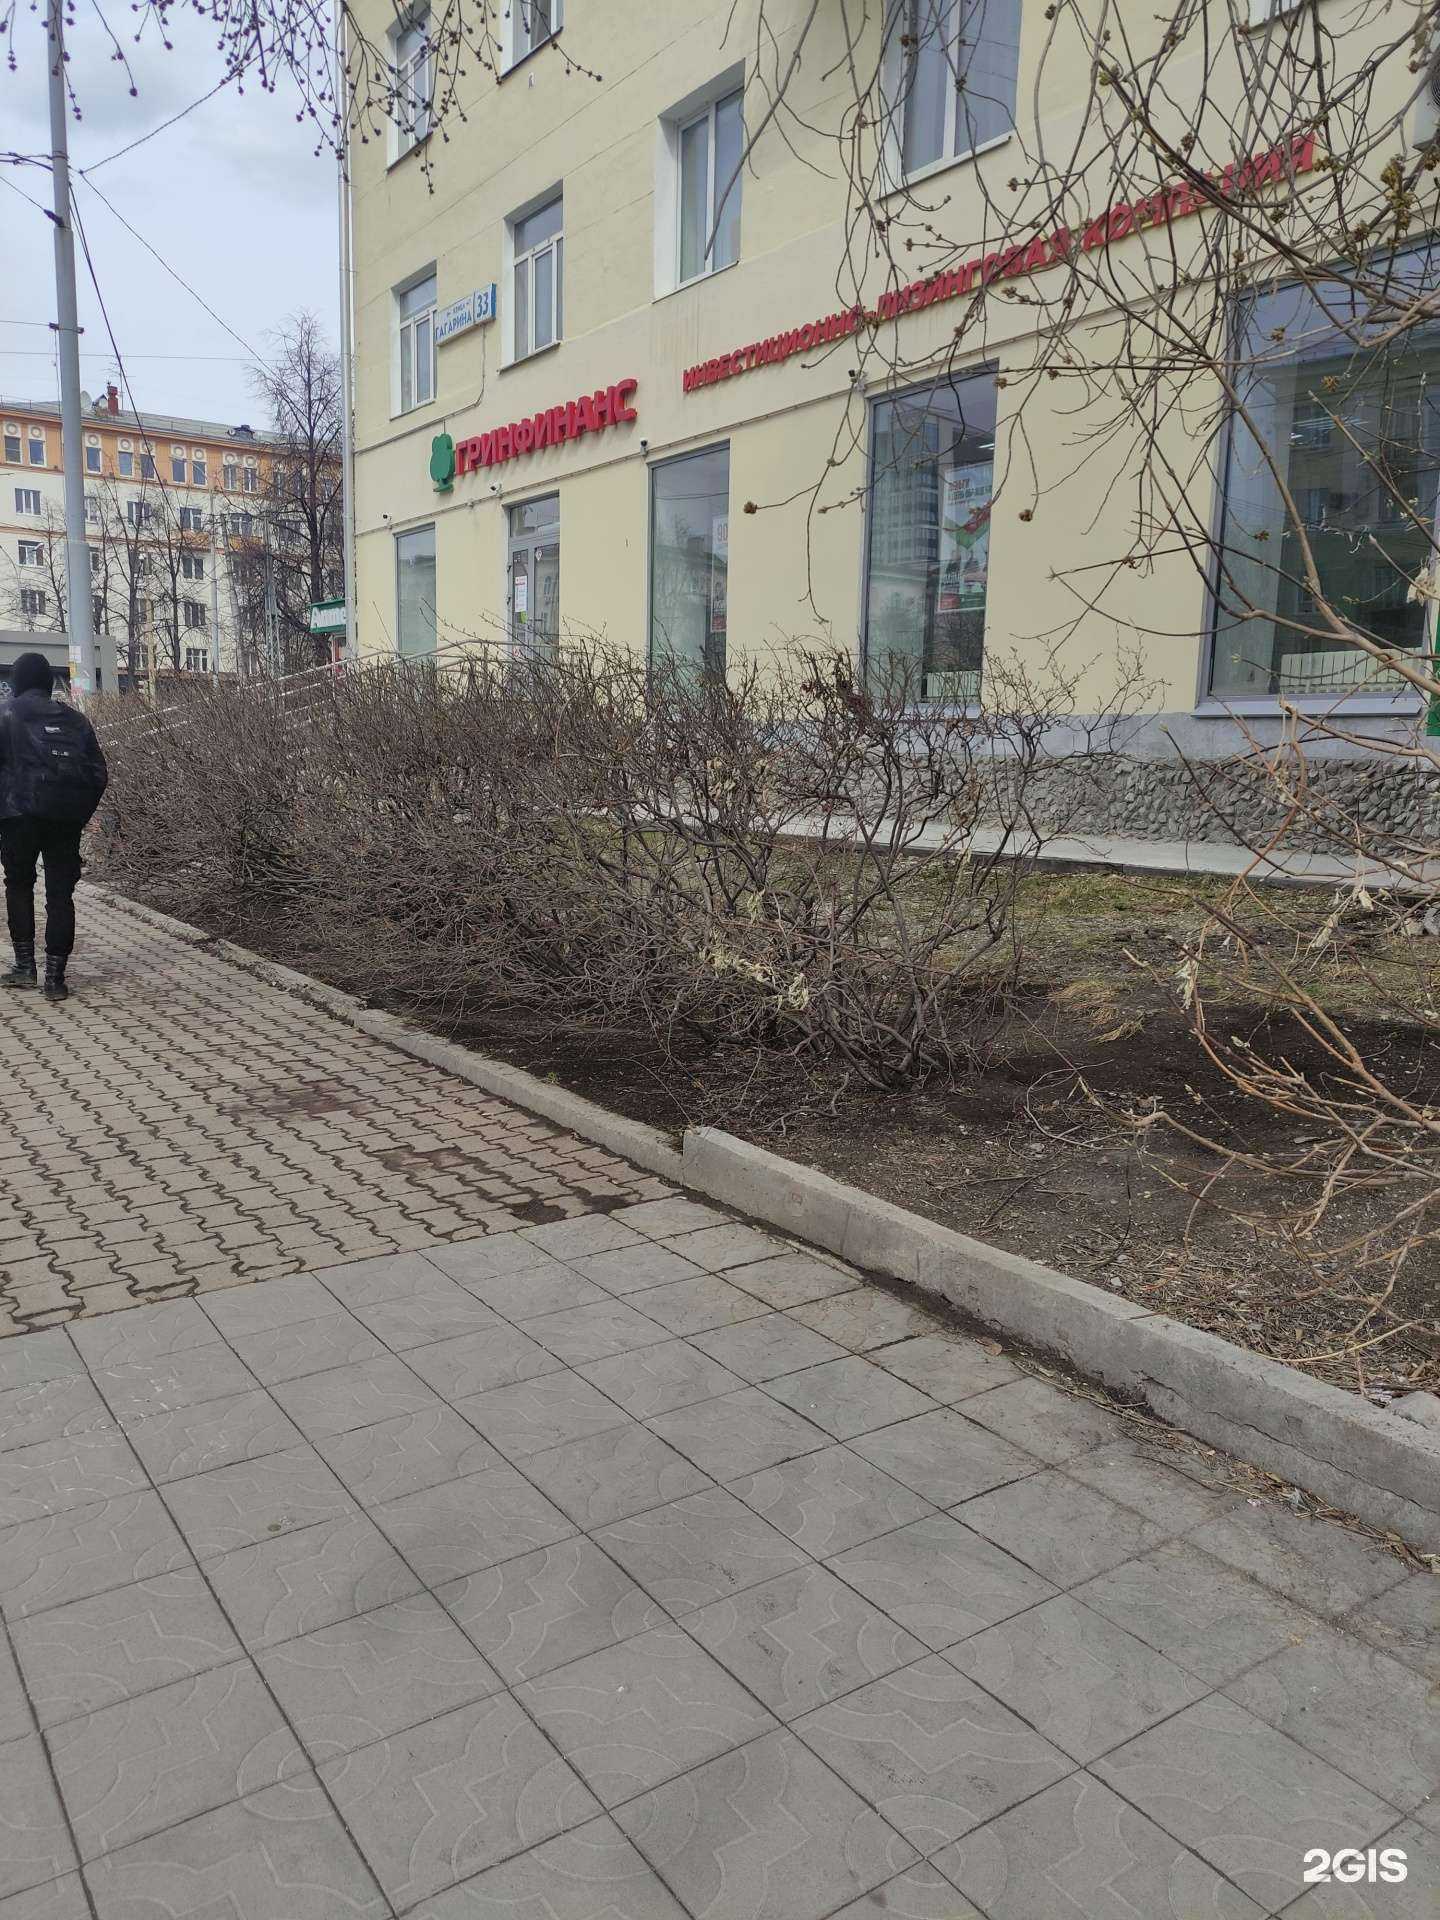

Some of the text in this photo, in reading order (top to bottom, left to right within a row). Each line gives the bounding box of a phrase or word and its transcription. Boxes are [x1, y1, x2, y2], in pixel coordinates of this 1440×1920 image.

[476, 291, 489, 319] 33
[435, 311, 472, 341] ГАГАРИНА
[455, 378, 638, 476] ГРИНФИНАНС
